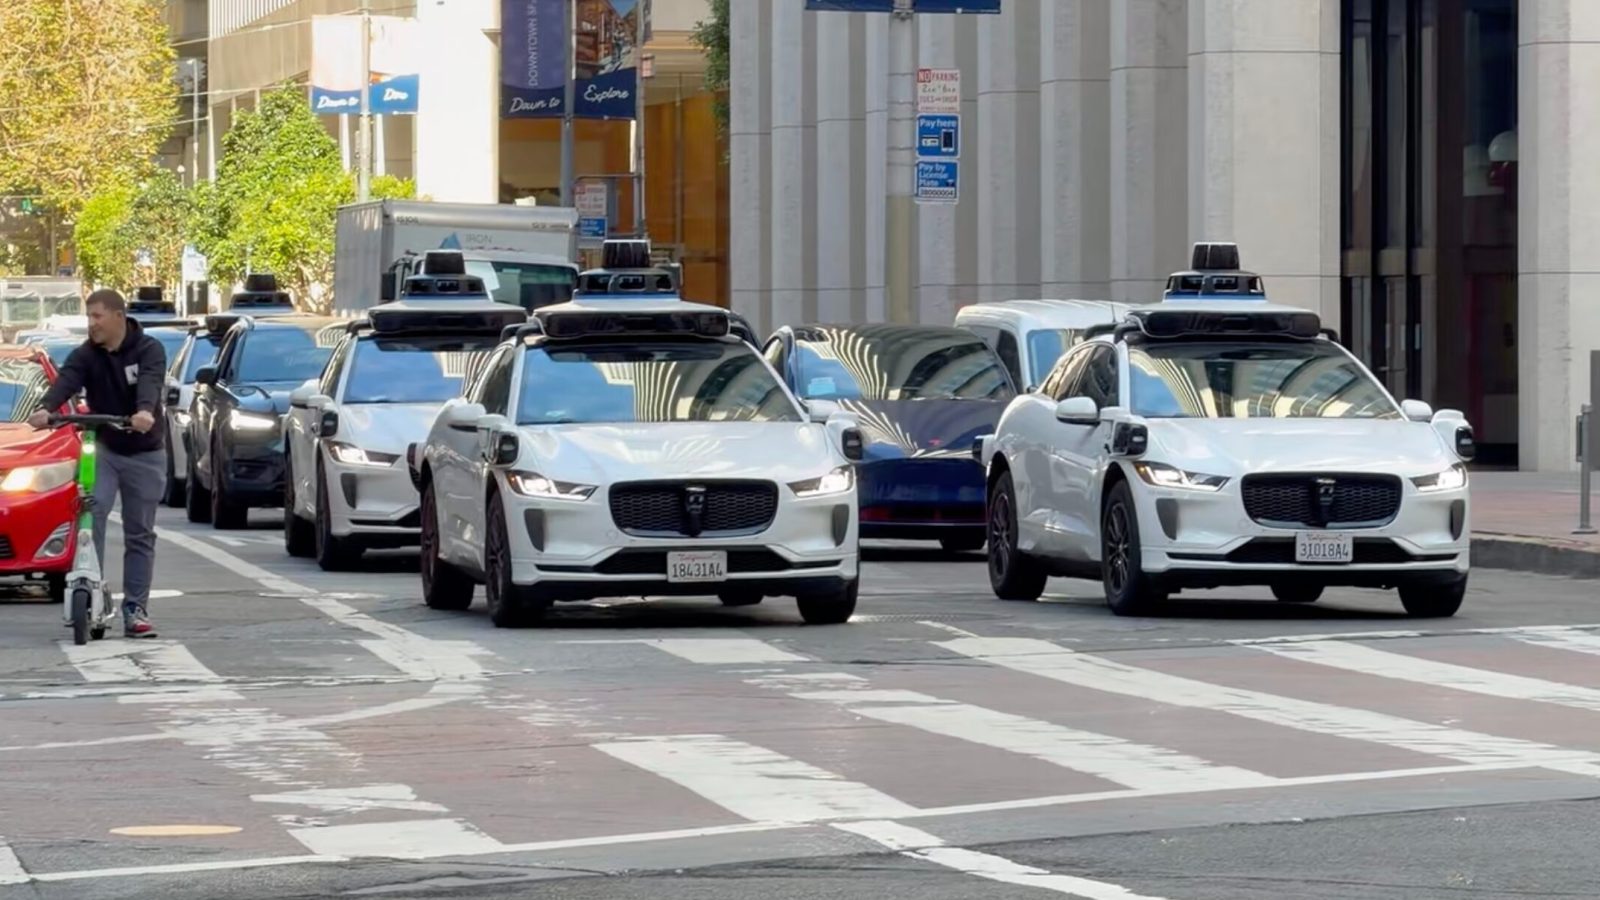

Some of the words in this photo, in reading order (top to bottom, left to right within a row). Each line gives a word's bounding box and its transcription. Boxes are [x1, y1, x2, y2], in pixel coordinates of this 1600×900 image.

[528, 17, 539, 87] DOWNTOWN
[919, 70, 931, 82] NO
[583, 84, 629, 102] Explore
[548, 96, 561, 108] to
[920, 119, 936, 129] Pay
[936, 118, 957, 127] here
[919, 163, 934, 173] Pay
[935, 162, 947, 173] by
[919, 171, 949, 179] License
[465, 233, 493, 244] IRON
[672, 562, 723, 578] 18431A4
